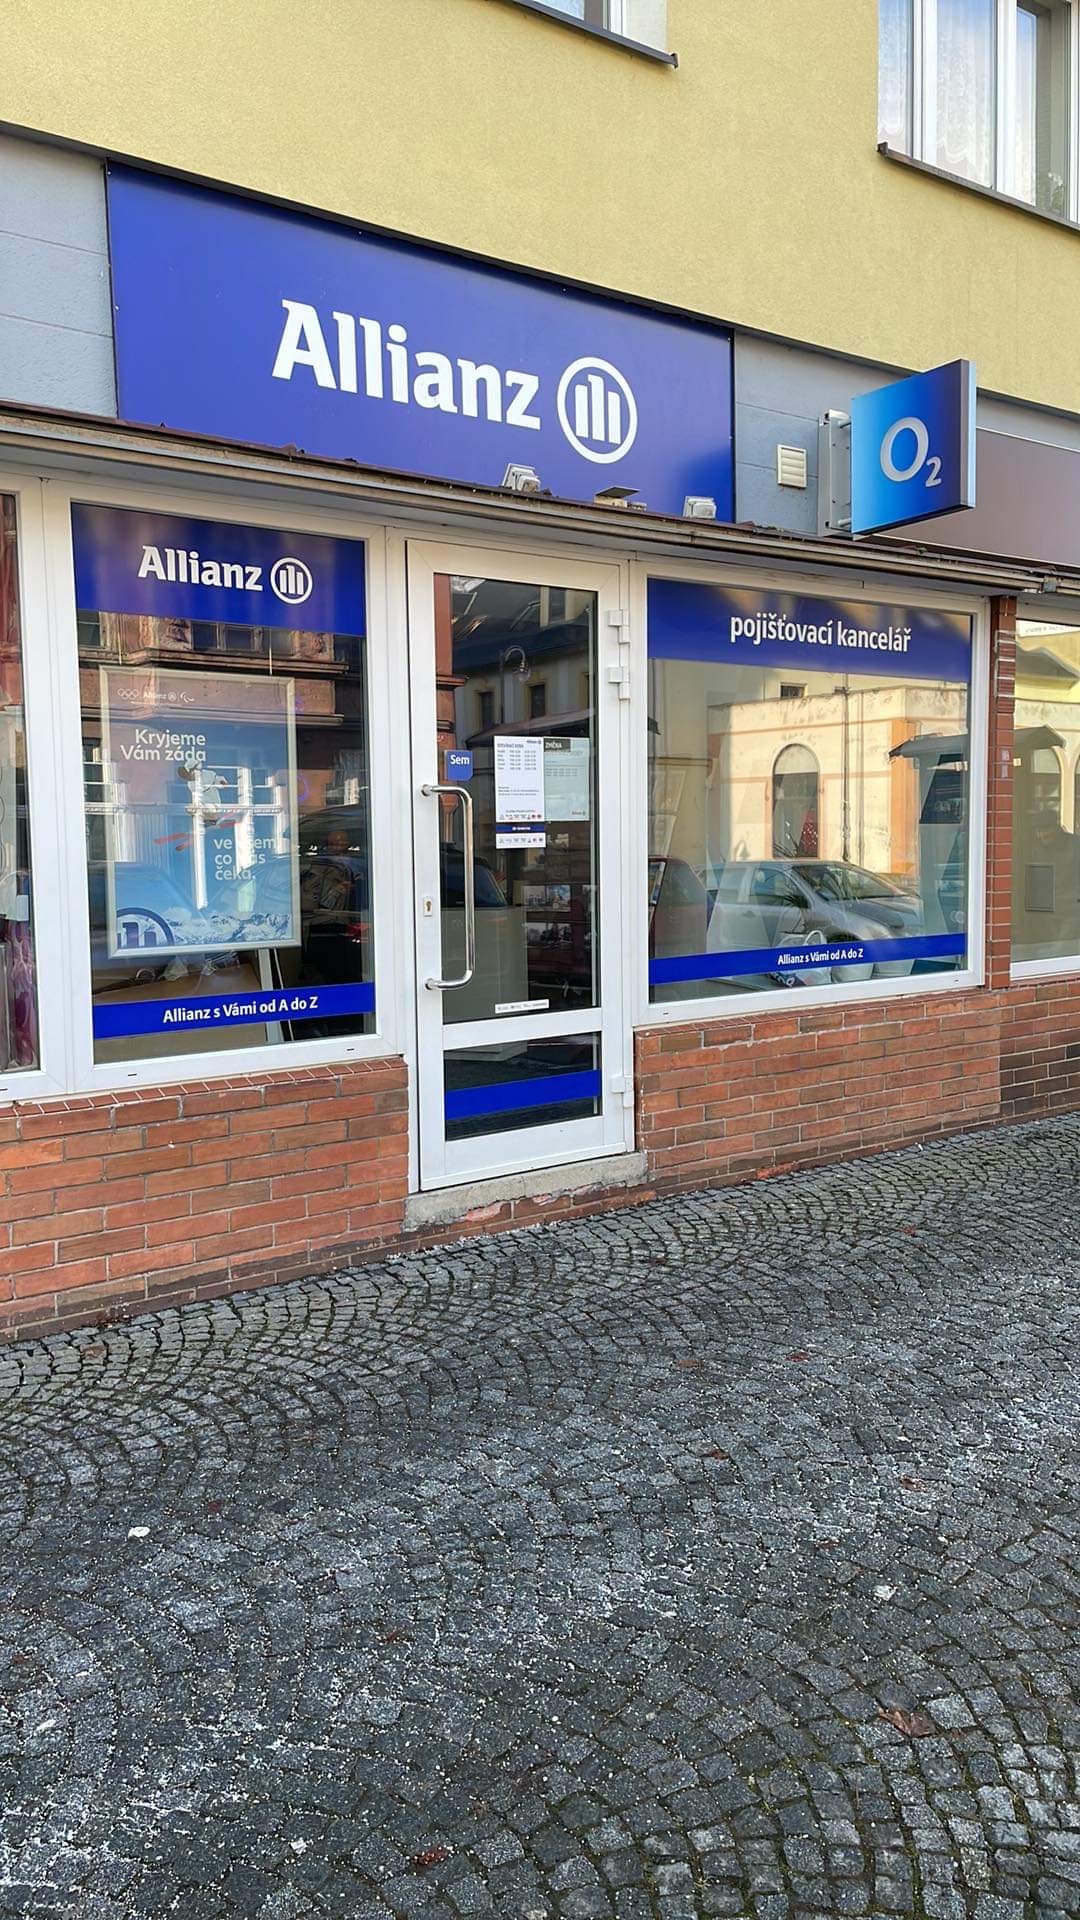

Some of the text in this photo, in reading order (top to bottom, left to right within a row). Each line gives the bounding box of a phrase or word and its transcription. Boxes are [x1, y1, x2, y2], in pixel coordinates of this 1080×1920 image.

[271, 299, 541, 430] Allianz
[137, 545, 263, 592] Allianz
[730, 612, 912, 652] pojišťovací kancelář
[135, 729, 206, 749] Kryjeme
[120, 745, 207, 762] Vám záda
[450, 754, 470, 765] Sem
[213, 838, 233, 849] ve
[214, 854, 233, 865] co
[777, 948, 864, 965] Allianz s Vámi od A do Z
[163, 996, 319, 1023] Allianz s Vámi od A do Z
